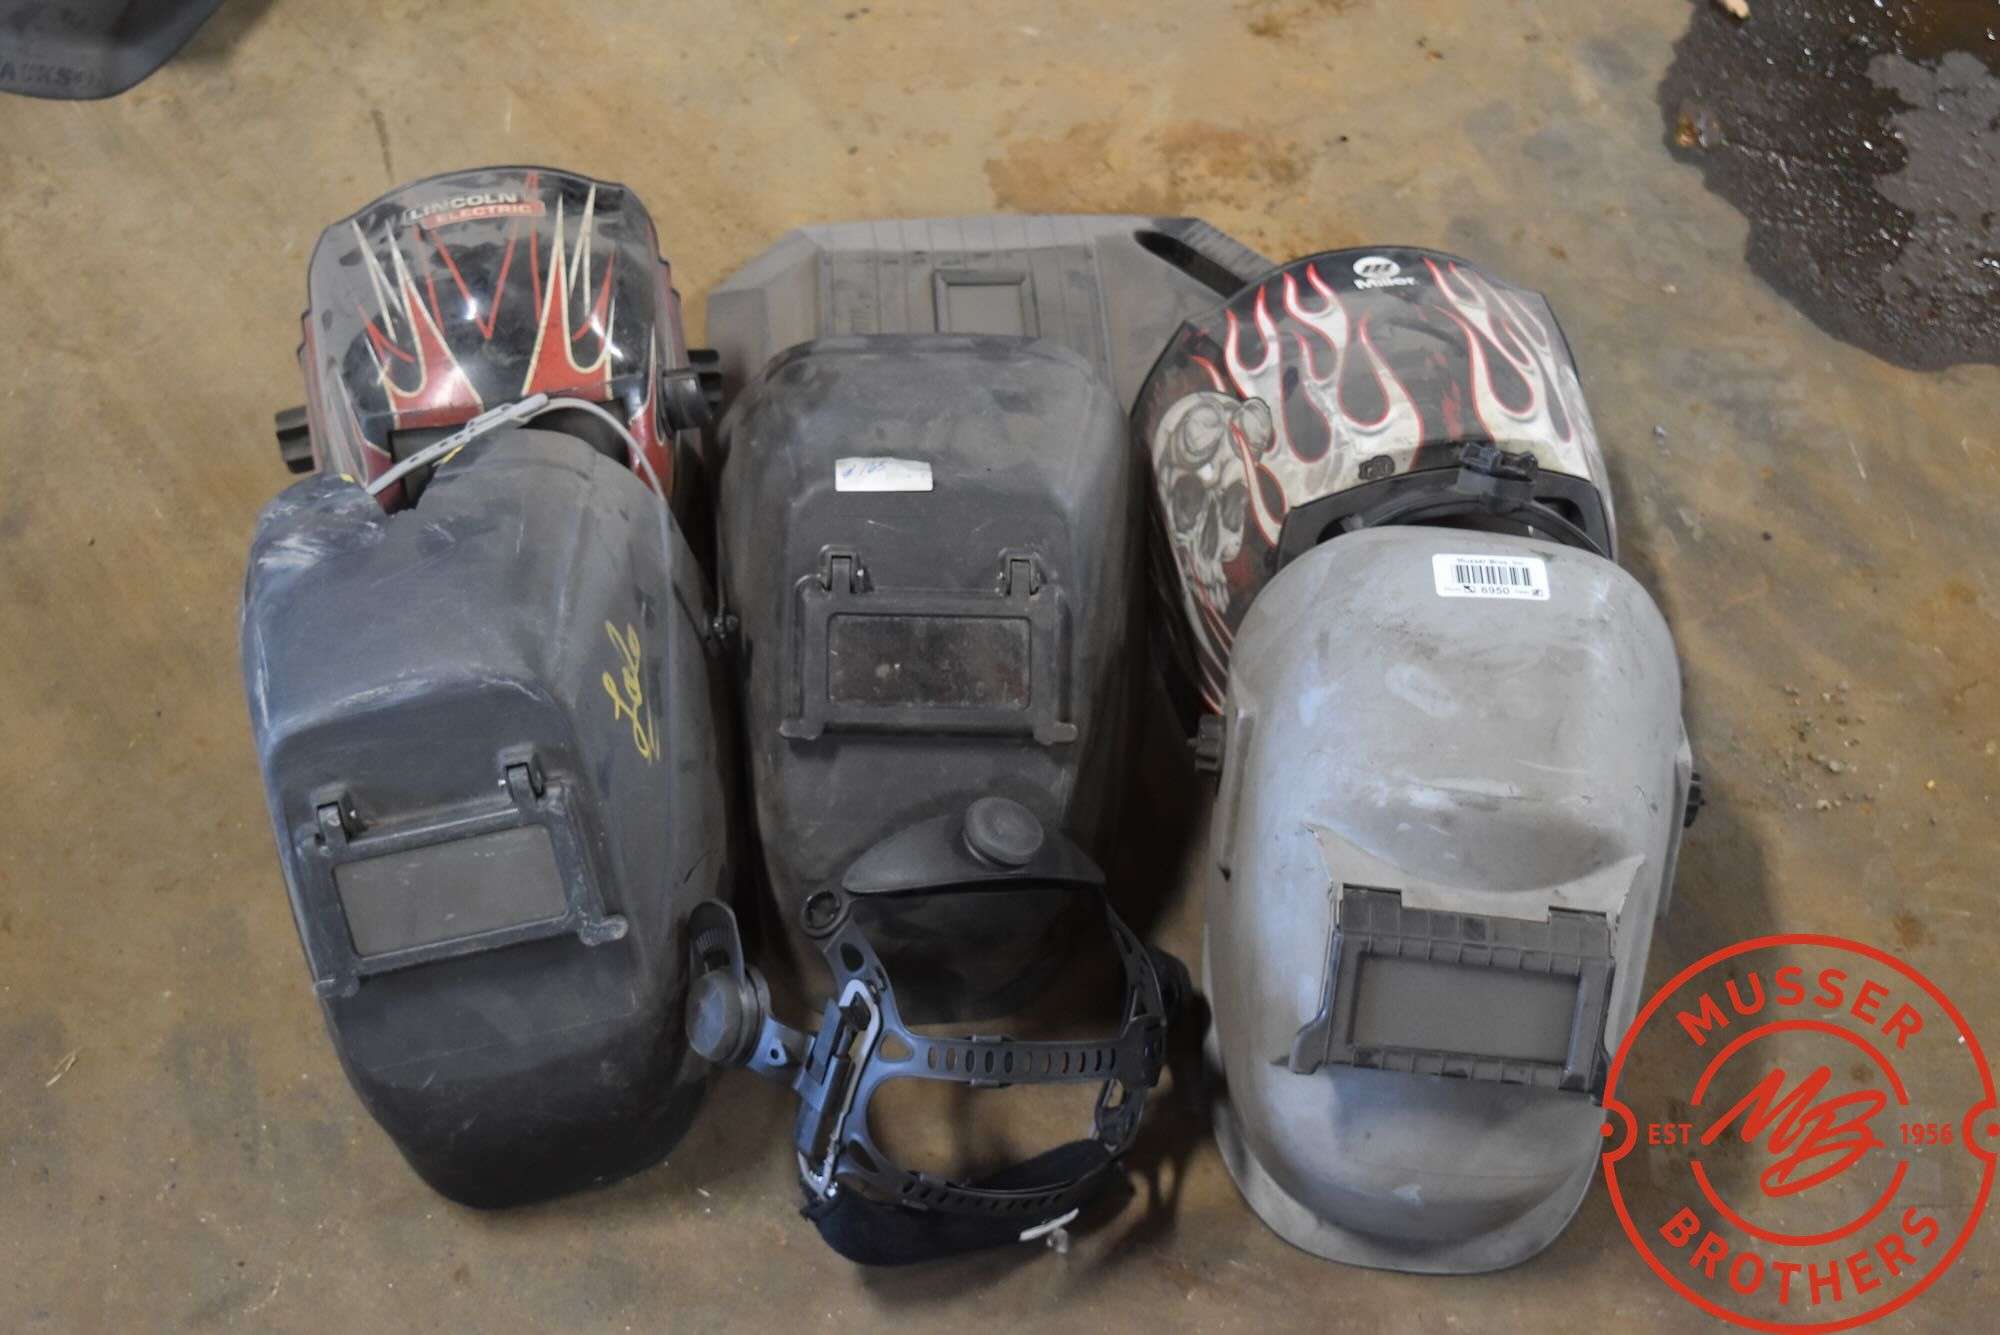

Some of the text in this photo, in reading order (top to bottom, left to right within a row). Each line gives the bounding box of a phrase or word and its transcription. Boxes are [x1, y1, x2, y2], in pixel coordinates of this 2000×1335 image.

[409, 193, 517, 220] LINCOLN
[435, 204, 533, 223] ELECTRIC
[1353, 277, 1416, 290] Miller
